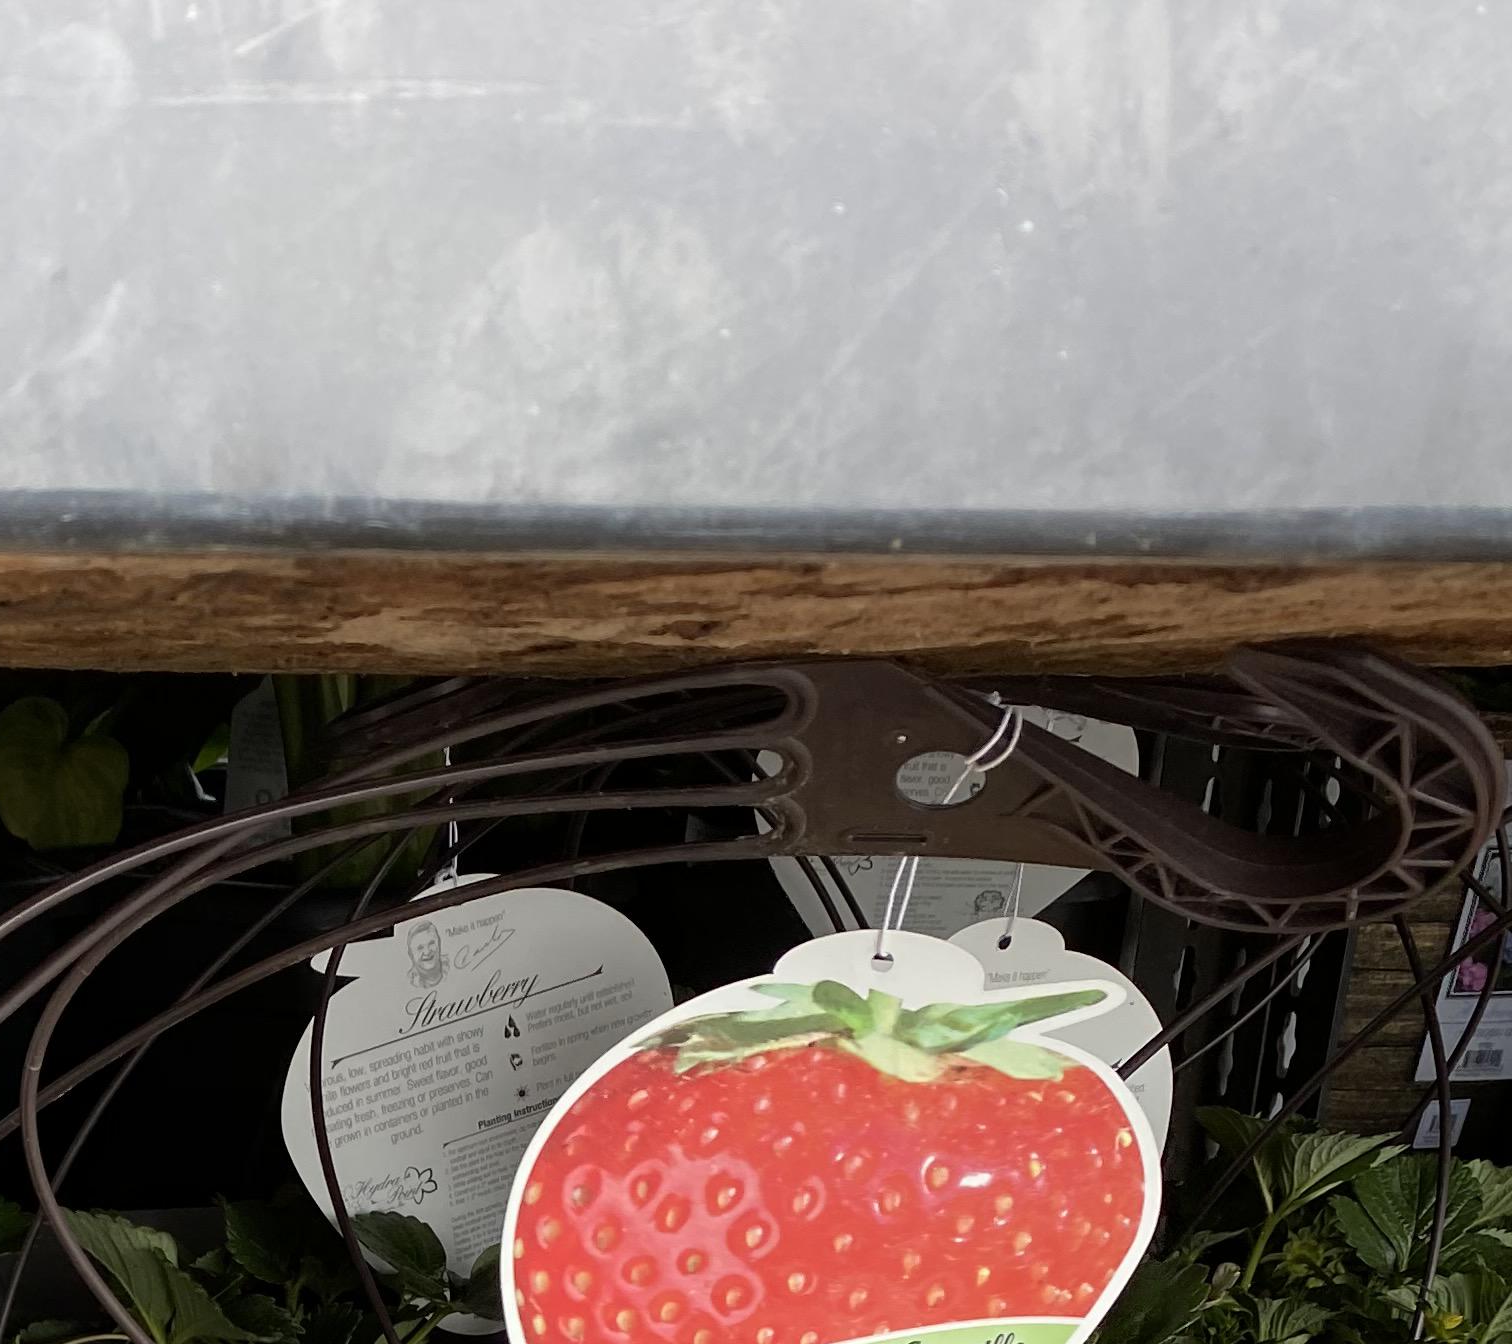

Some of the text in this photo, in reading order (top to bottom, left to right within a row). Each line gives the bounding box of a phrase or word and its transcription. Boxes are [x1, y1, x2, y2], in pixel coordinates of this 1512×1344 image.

[398, 968, 539, 1035] Strawberry
[339, 1043, 480, 1097] flowers and bright red fruit that is
[369, 1049, 412, 1072] spreading
[413, 1041, 434, 1057] habit
[436, 1036, 455, 1050] with
[456, 1025, 484, 1043] showy
[355, 1096, 364, 1108] in
[407, 1074, 434, 1091] Sweet
[464, 1055, 488, 1073] good
[381, 1095, 416, 1115] freezing
[417, 1093, 426, 1104] or
[474, 1068, 494, 1084] Can
[334, 1087, 489, 1149] grown in containers or planted in the
[390, 1123, 424, 1145] ground.
[478, 1096, 561, 1130] Planting Instruction
[351, 1174, 401, 1200] Hydra
